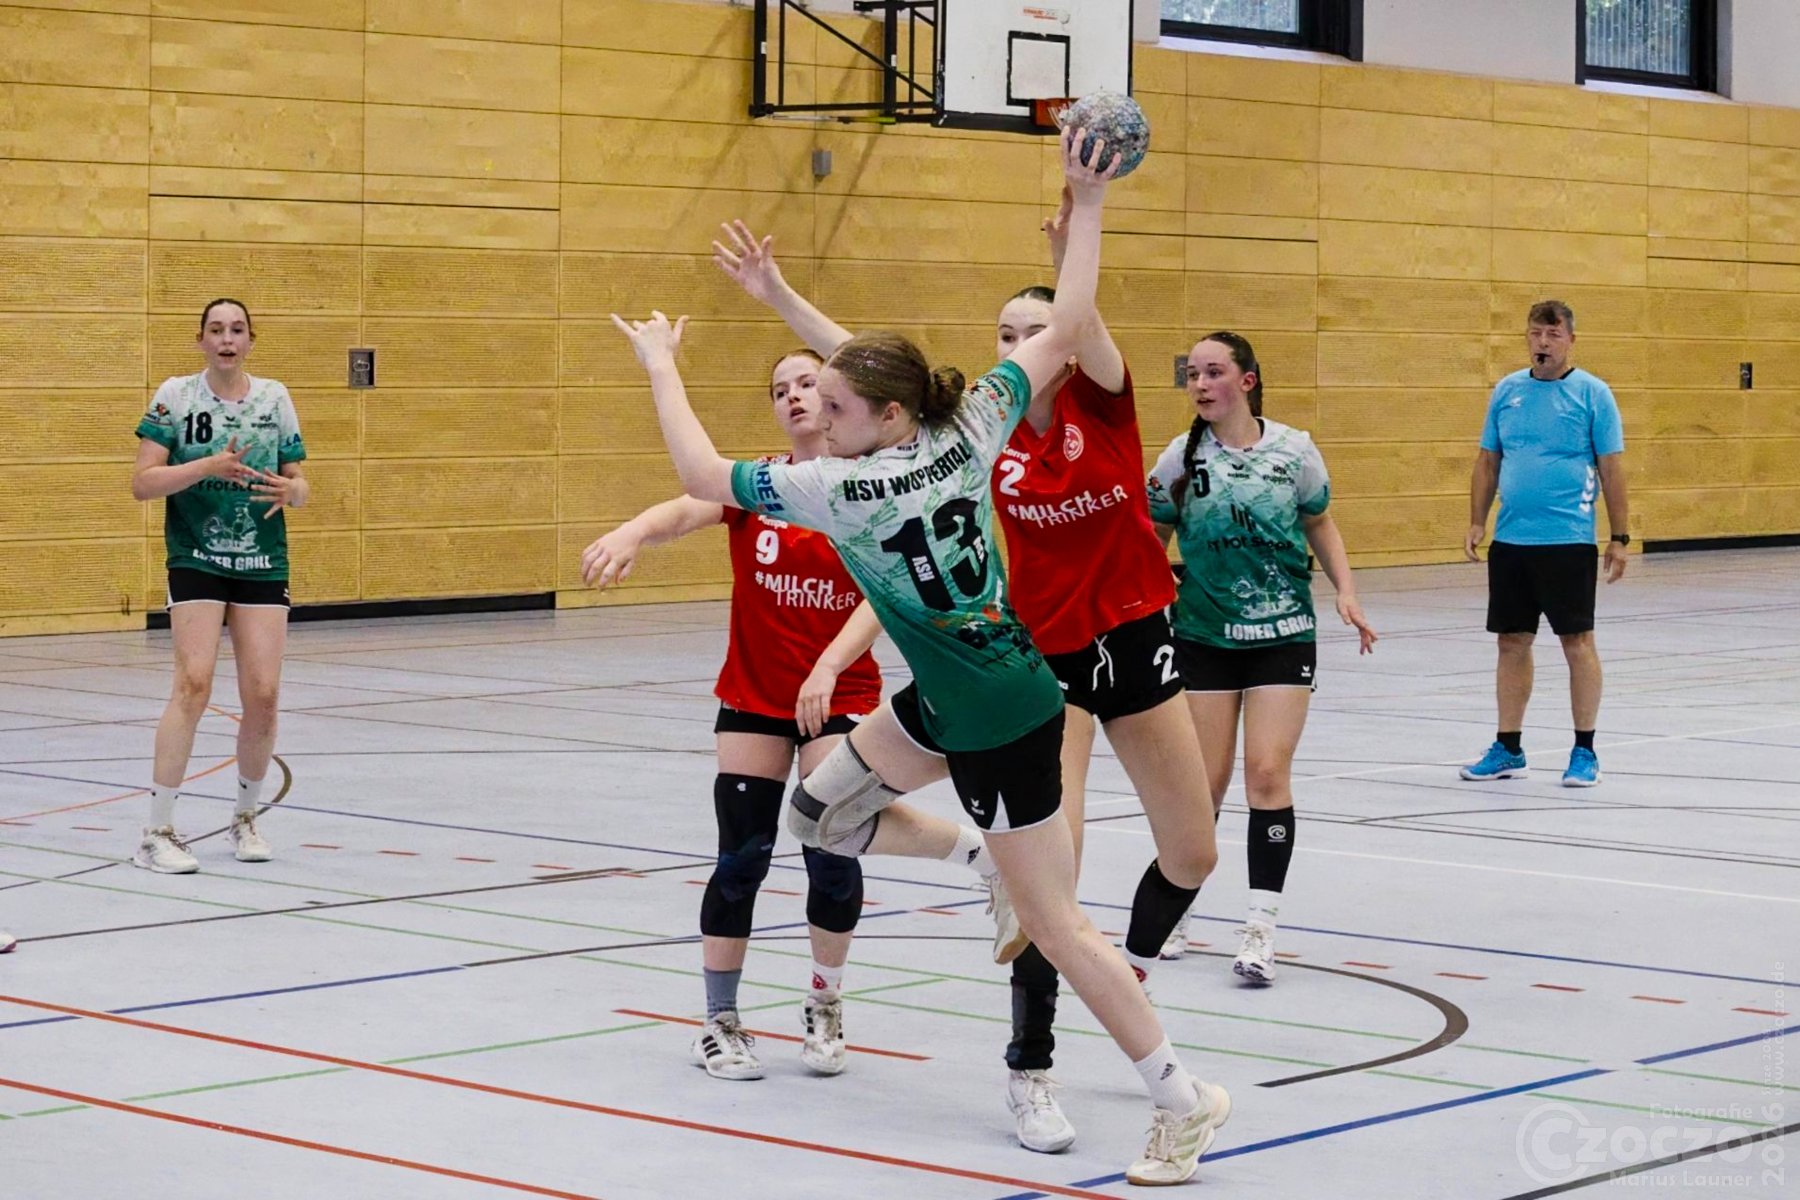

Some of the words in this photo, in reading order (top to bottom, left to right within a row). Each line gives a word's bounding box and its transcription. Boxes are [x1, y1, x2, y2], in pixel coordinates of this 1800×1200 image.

[184, 411, 213, 445] 18
[842, 478, 886, 502] HSV
[999, 459, 1026, 497] 2
[1007, 489, 1094, 522] #MILCH
[755, 529, 780, 565] 9
[880, 498, 989, 613] 13
[755, 570, 834, 596] #MILCH
[912, 555, 935, 583] HSV
[772, 588, 857, 611] TRINKER
[1153, 644, 1180, 686] 2
